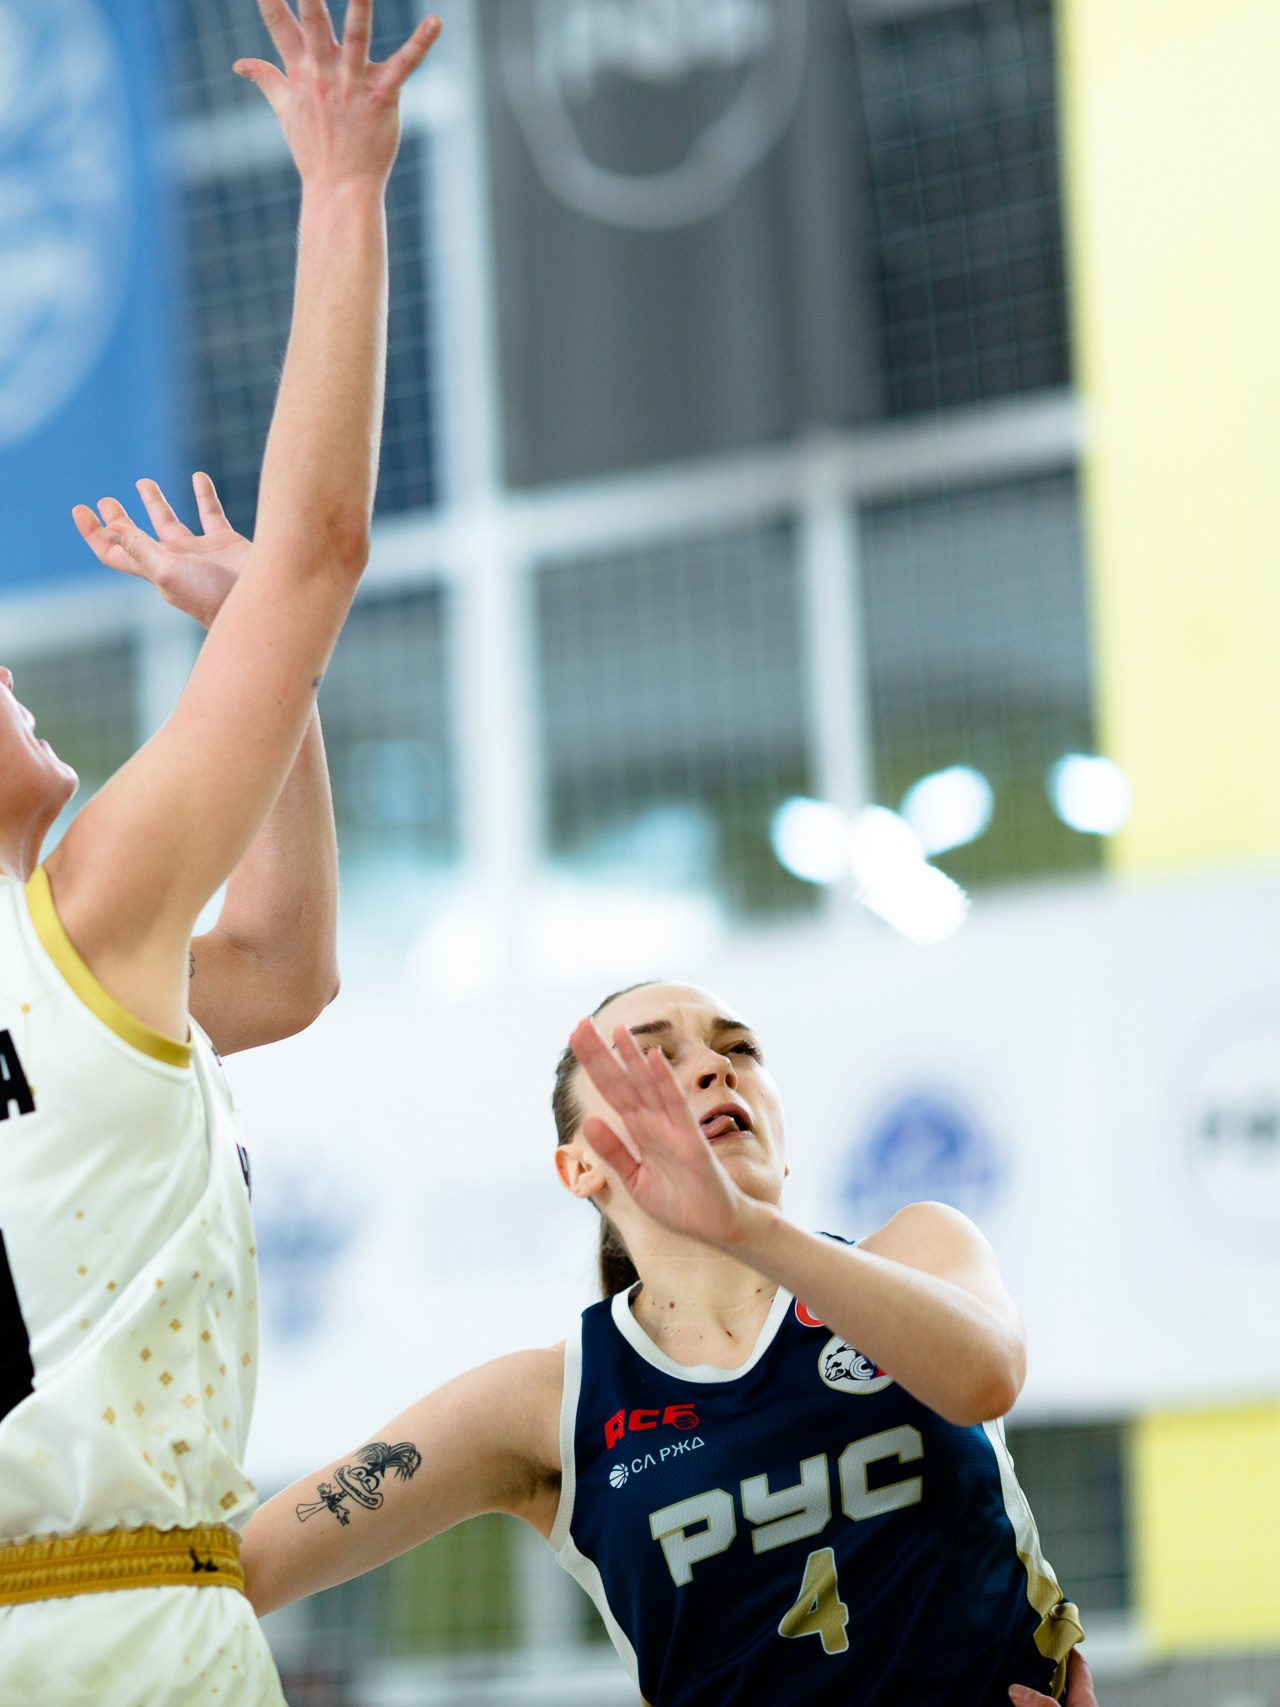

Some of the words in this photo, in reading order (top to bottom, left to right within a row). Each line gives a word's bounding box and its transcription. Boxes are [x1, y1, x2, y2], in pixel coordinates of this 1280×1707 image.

[604, 1403, 699, 1450] АСБ
[659, 1436, 705, 1462] РЖД
[648, 1423, 924, 1588] РУС
[778, 1546, 850, 1656] 4
